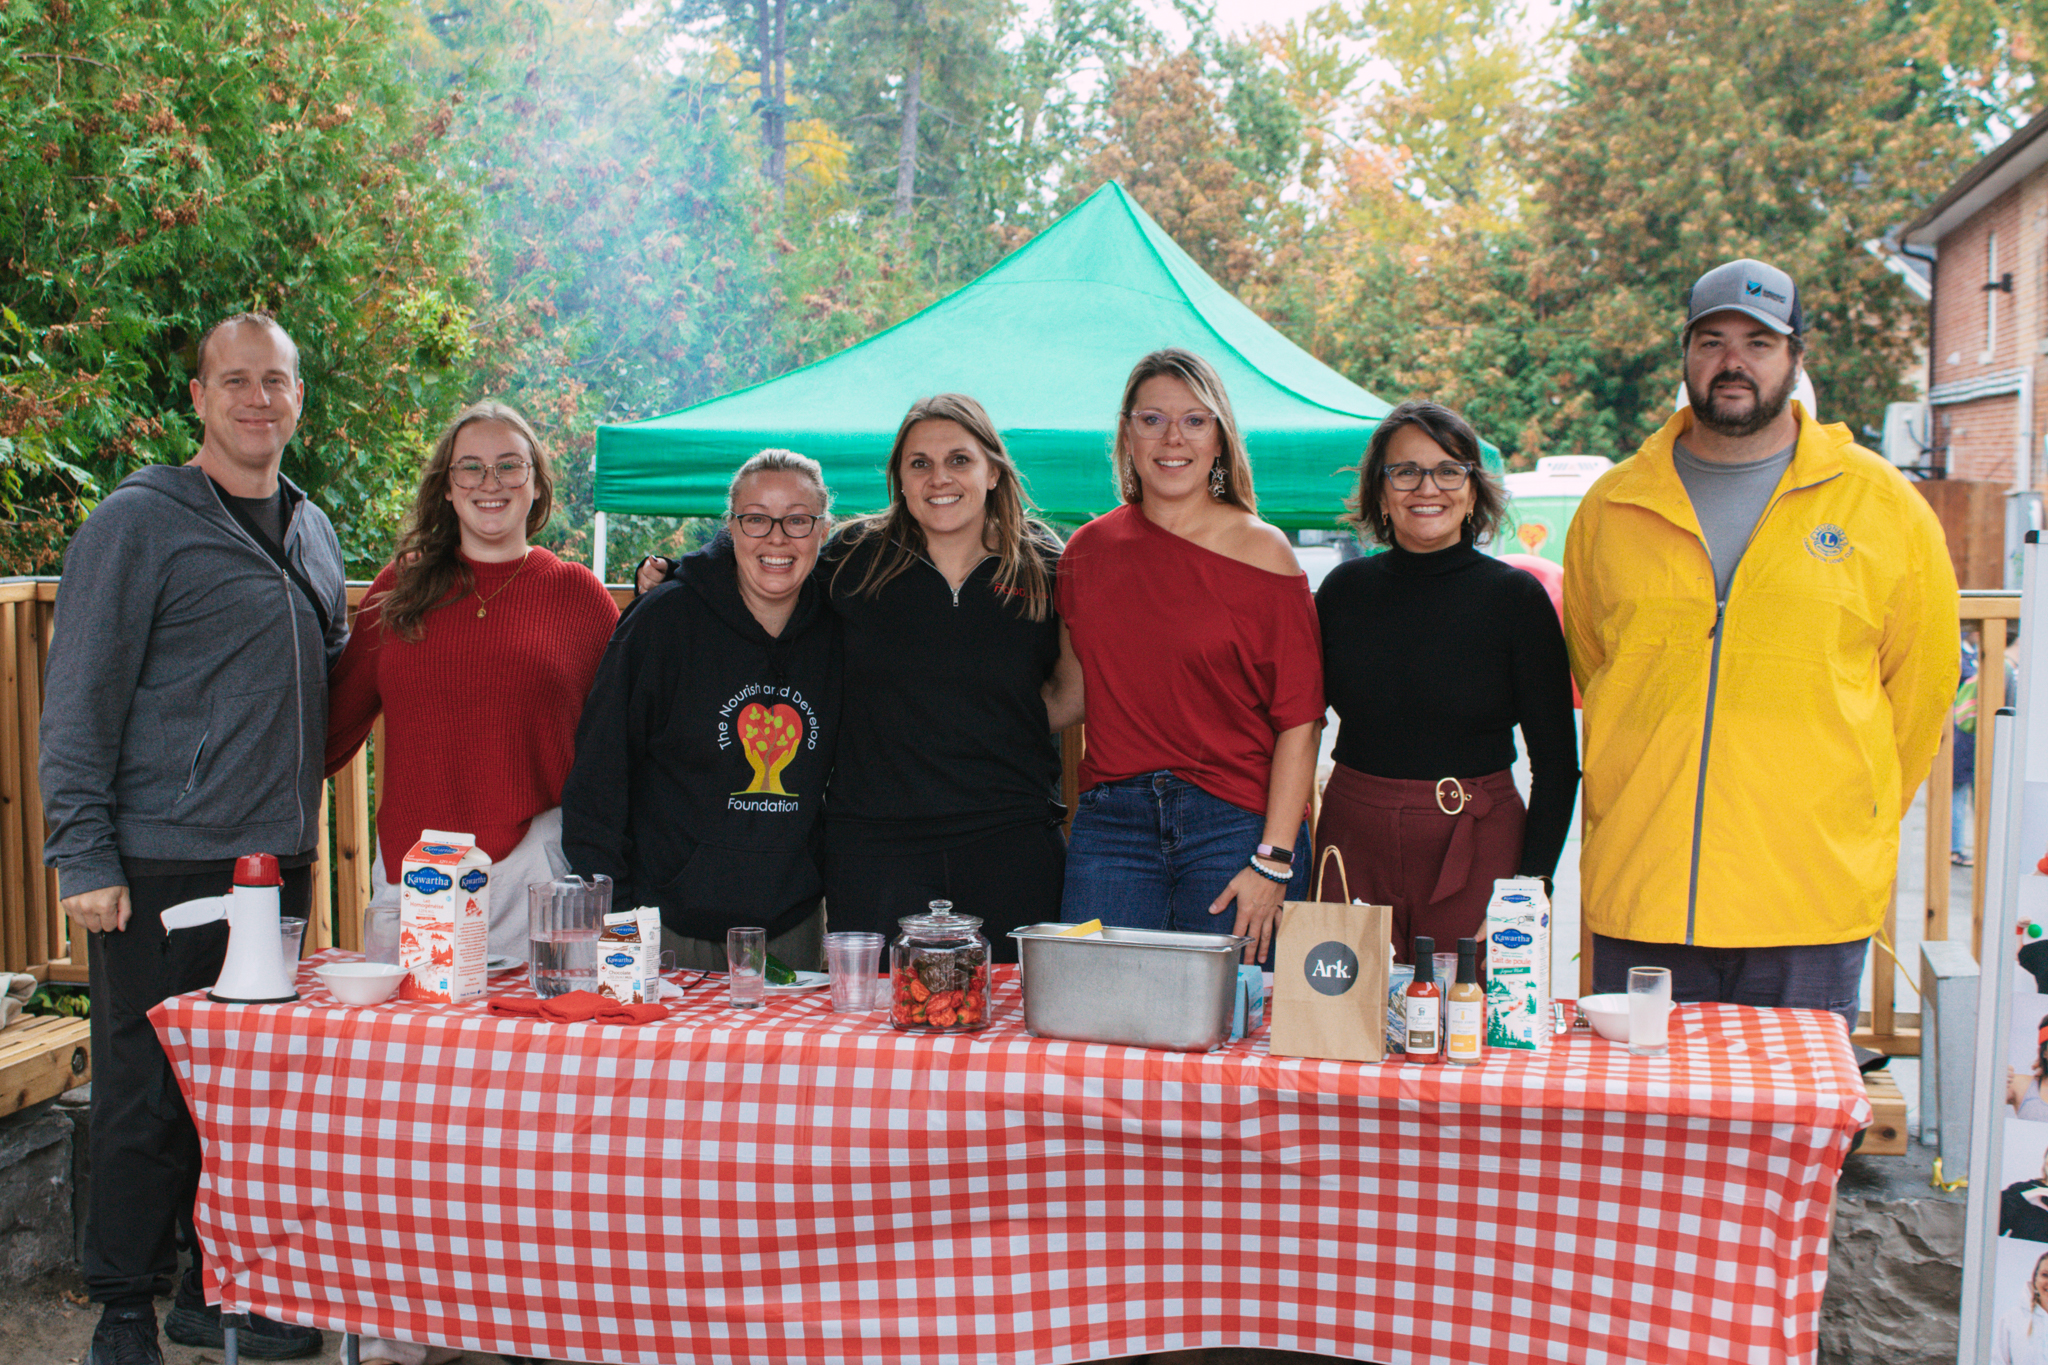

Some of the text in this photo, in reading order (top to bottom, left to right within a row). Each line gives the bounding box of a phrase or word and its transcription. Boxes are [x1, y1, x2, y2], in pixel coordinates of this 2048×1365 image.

[1824, 533, 1835, 546] L
[719, 682, 761, 718] Nourish
[792, 691, 820, 750] Develop
[717, 722, 732, 750] The
[728, 798, 799, 812] Foundation
[407, 874, 449, 886] Kawartha
[461, 876, 487, 887] Kawartha
[1495, 934, 1530, 942] Kawartha
[1312, 959, 1351, 978] Ark.
[1513, 958, 1531, 967] poule
